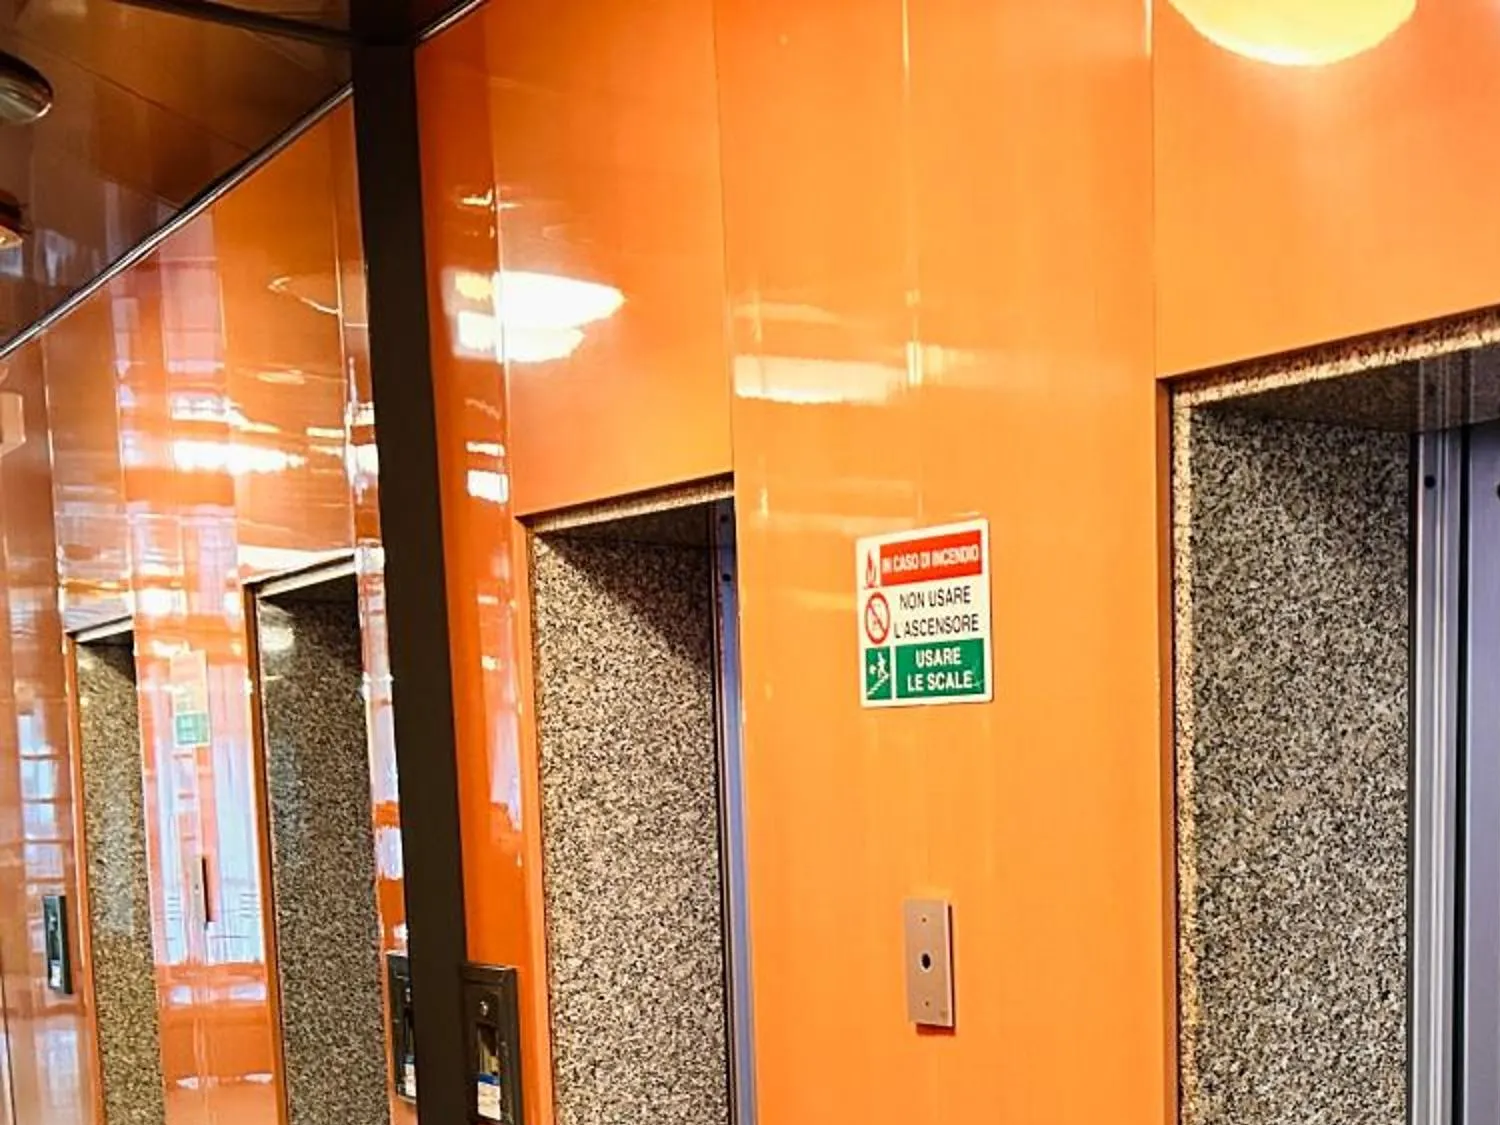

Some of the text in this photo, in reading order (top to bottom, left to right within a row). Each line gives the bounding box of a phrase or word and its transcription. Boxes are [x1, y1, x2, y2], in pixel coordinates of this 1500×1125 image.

[893, 553, 919, 570] CASO
[920, 552, 931, 567] DI
[932, 545, 979, 566] INCENDIO
[899, 585, 971, 610] NON USARE
[915, 647, 962, 669] USARE
[907, 671, 973, 692] LE SCALE
